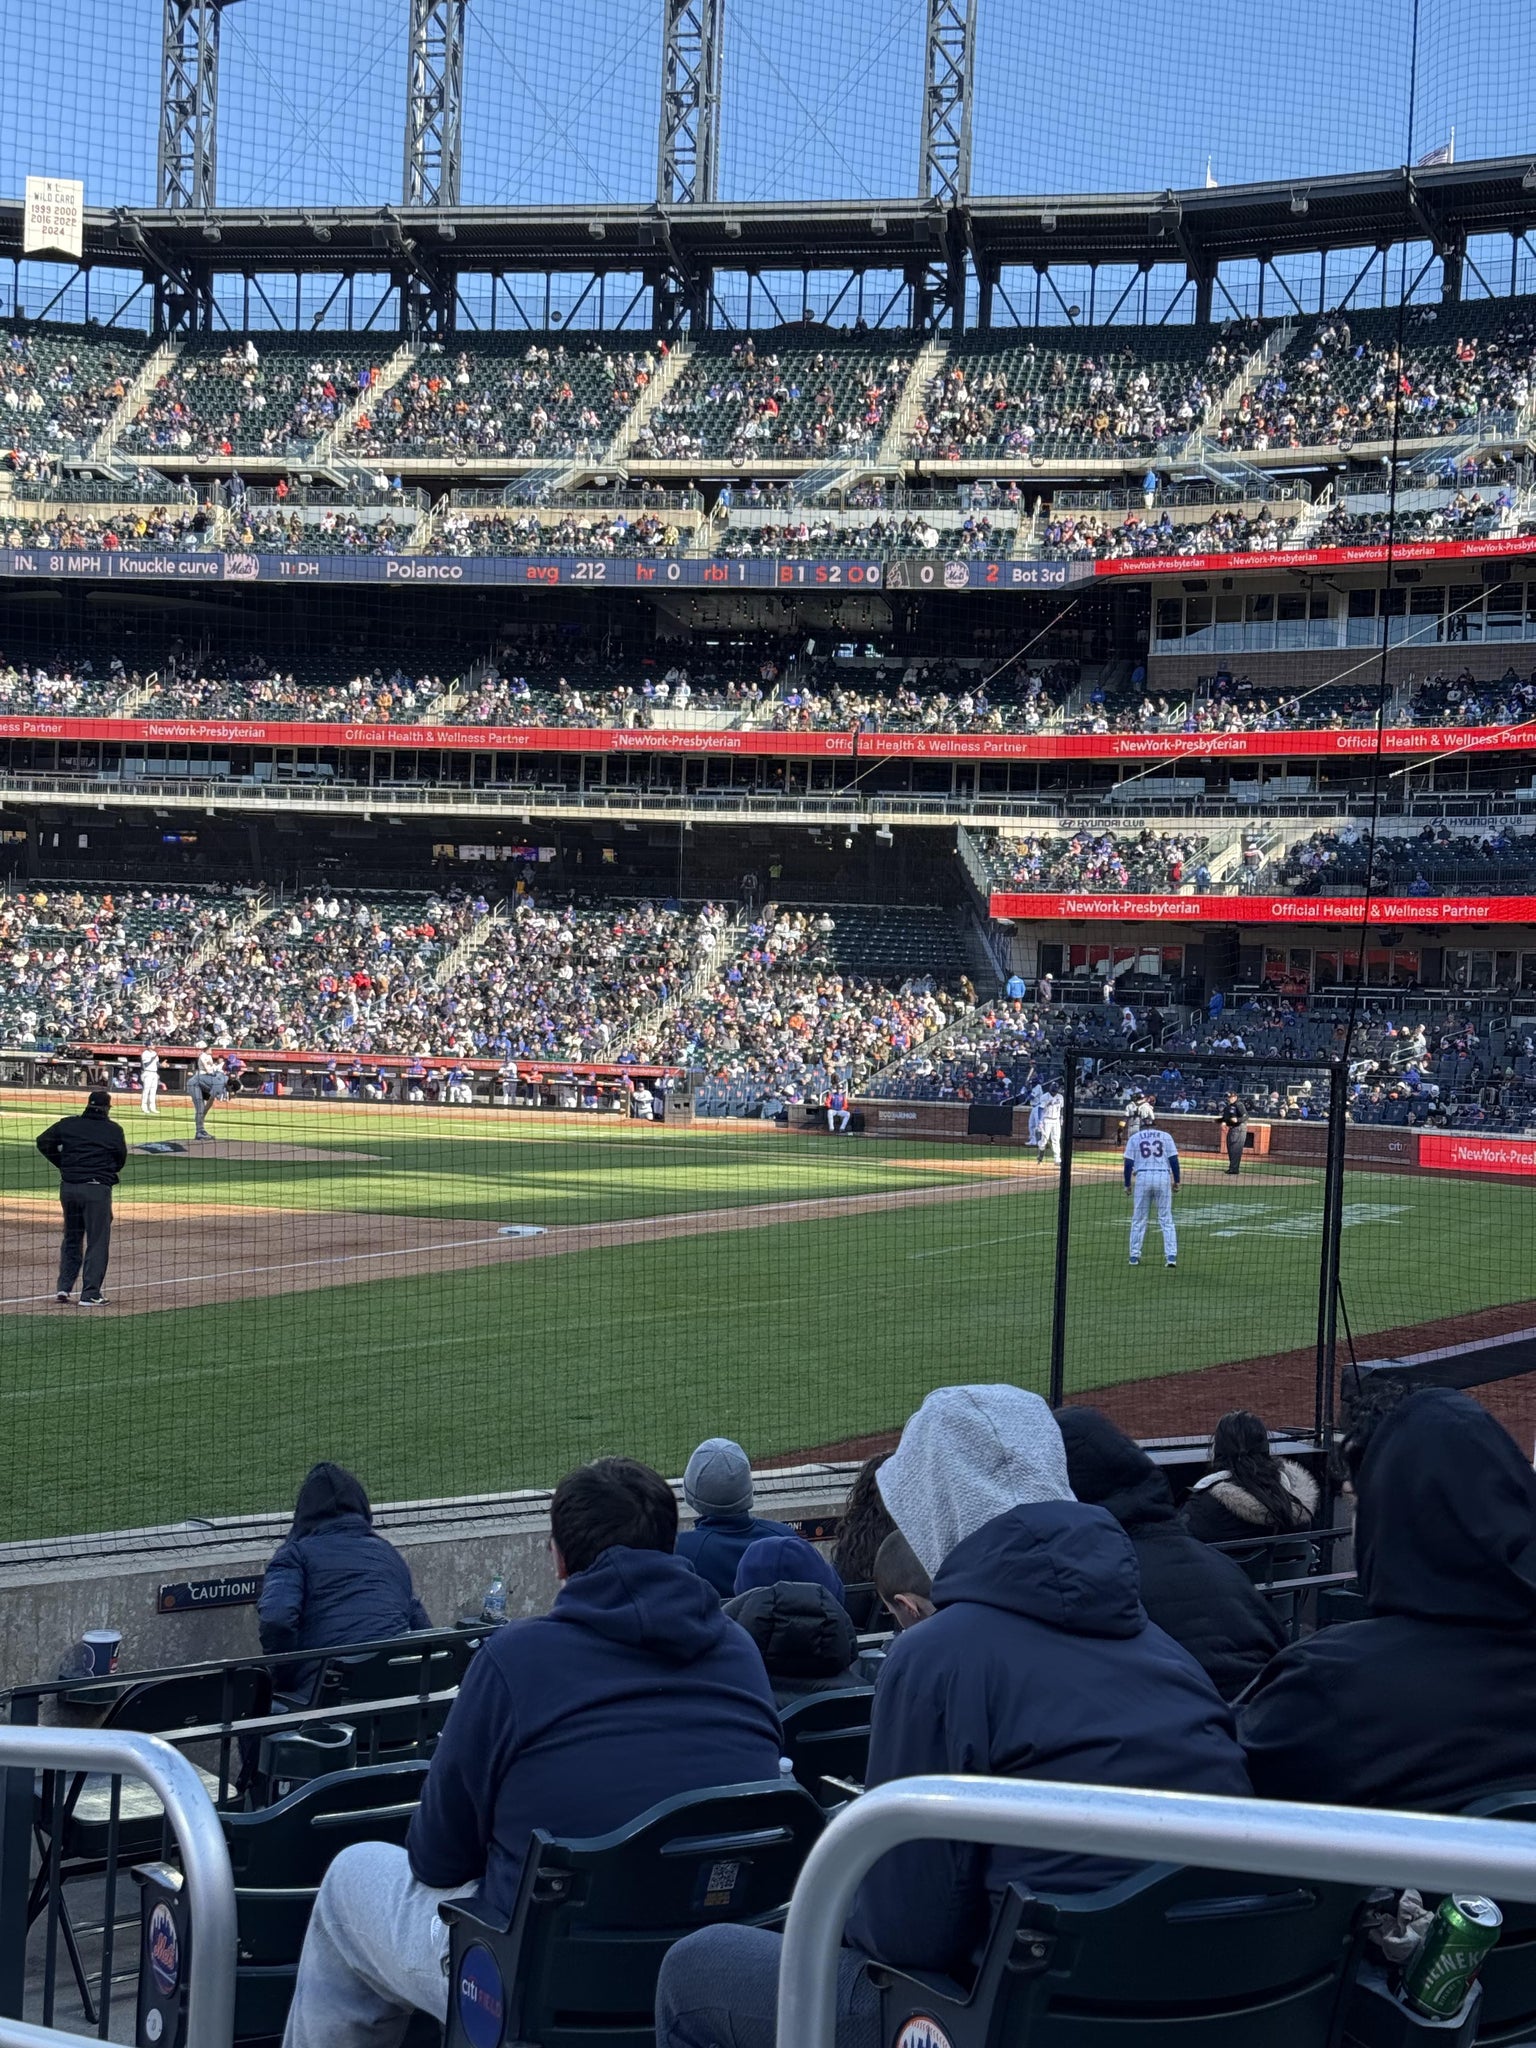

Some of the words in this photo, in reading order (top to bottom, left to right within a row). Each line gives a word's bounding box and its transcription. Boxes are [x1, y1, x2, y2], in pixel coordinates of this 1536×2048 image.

[31, 204, 52, 214] 1999
[54, 206, 77, 217] 2000
[31, 214, 52, 224] 2016
[54, 216, 78, 227] 2022
[42, 225, 65, 236] 2024
[1233, 553, 1318, 566] NewYork-Presbyterian
[1347, 547, 1436, 559] NewYork-Pesbyterian
[14, 555, 38, 571] IN.
[49, 556, 64, 571] 81
[68, 556, 101, 572] MPH
[119, 557, 175, 574] Knuckle
[179, 561, 219, 575] curve
[298, 562, 319, 576] DH
[386, 562, 464, 579] Polanco
[526, 565, 560, 584] avg
[570, 562, 606, 581] .212
[636, 563, 656, 581] hr
[667, 563, 681, 581] 0
[703, 564, 729, 582] rbi
[738, 564, 745, 581] 1
[1123, 560, 1205, 571] NewYork-Presbyterian
[920, 565, 934, 584] 0
[985, 565, 1000, 583] 2
[1012, 568, 1038, 583] Bot
[1041, 568, 1065, 583] 3rd
[22, 722, 63, 733] Partner
[149, 724, 266, 739] NewYork-Presbyterian
[345, 730, 385, 742] Official
[387, 730, 424, 742] Health
[426, 731, 435, 742] &
[436, 732, 486, 744] Wellness
[488, 733, 530, 745] Partner
[618, 734, 741, 750] NewYork-Presbyterian
[1120, 737, 1247, 753] NewYork-Presbyterian
[1336, 736, 1379, 748] Officia
[1385, 734, 1428, 747] Health
[1430, 734, 1441, 746] &
[1443, 733, 1499, 746] Wellness
[1501, 731, 1536, 744] Partn
[876, 739, 915, 750] Health
[917, 740, 926, 751] &
[929, 740, 981, 752] Wellness
[983, 741, 1028, 753] Partner
[1066, 899, 1200, 917] NewYork-Presbyterian
[1271, 903, 1320, 917] Official
[1370, 904, 1381, 917] &
[1383, 904, 1439, 918] Wellness
[1442, 904, 1490, 918] Partner
[1139, 1140, 1163, 1159] 63
[191, 1582, 256, 1600] CAUTION!
[154, 1932, 175, 1970] Mets
[461, 1978, 478, 2002] citi
